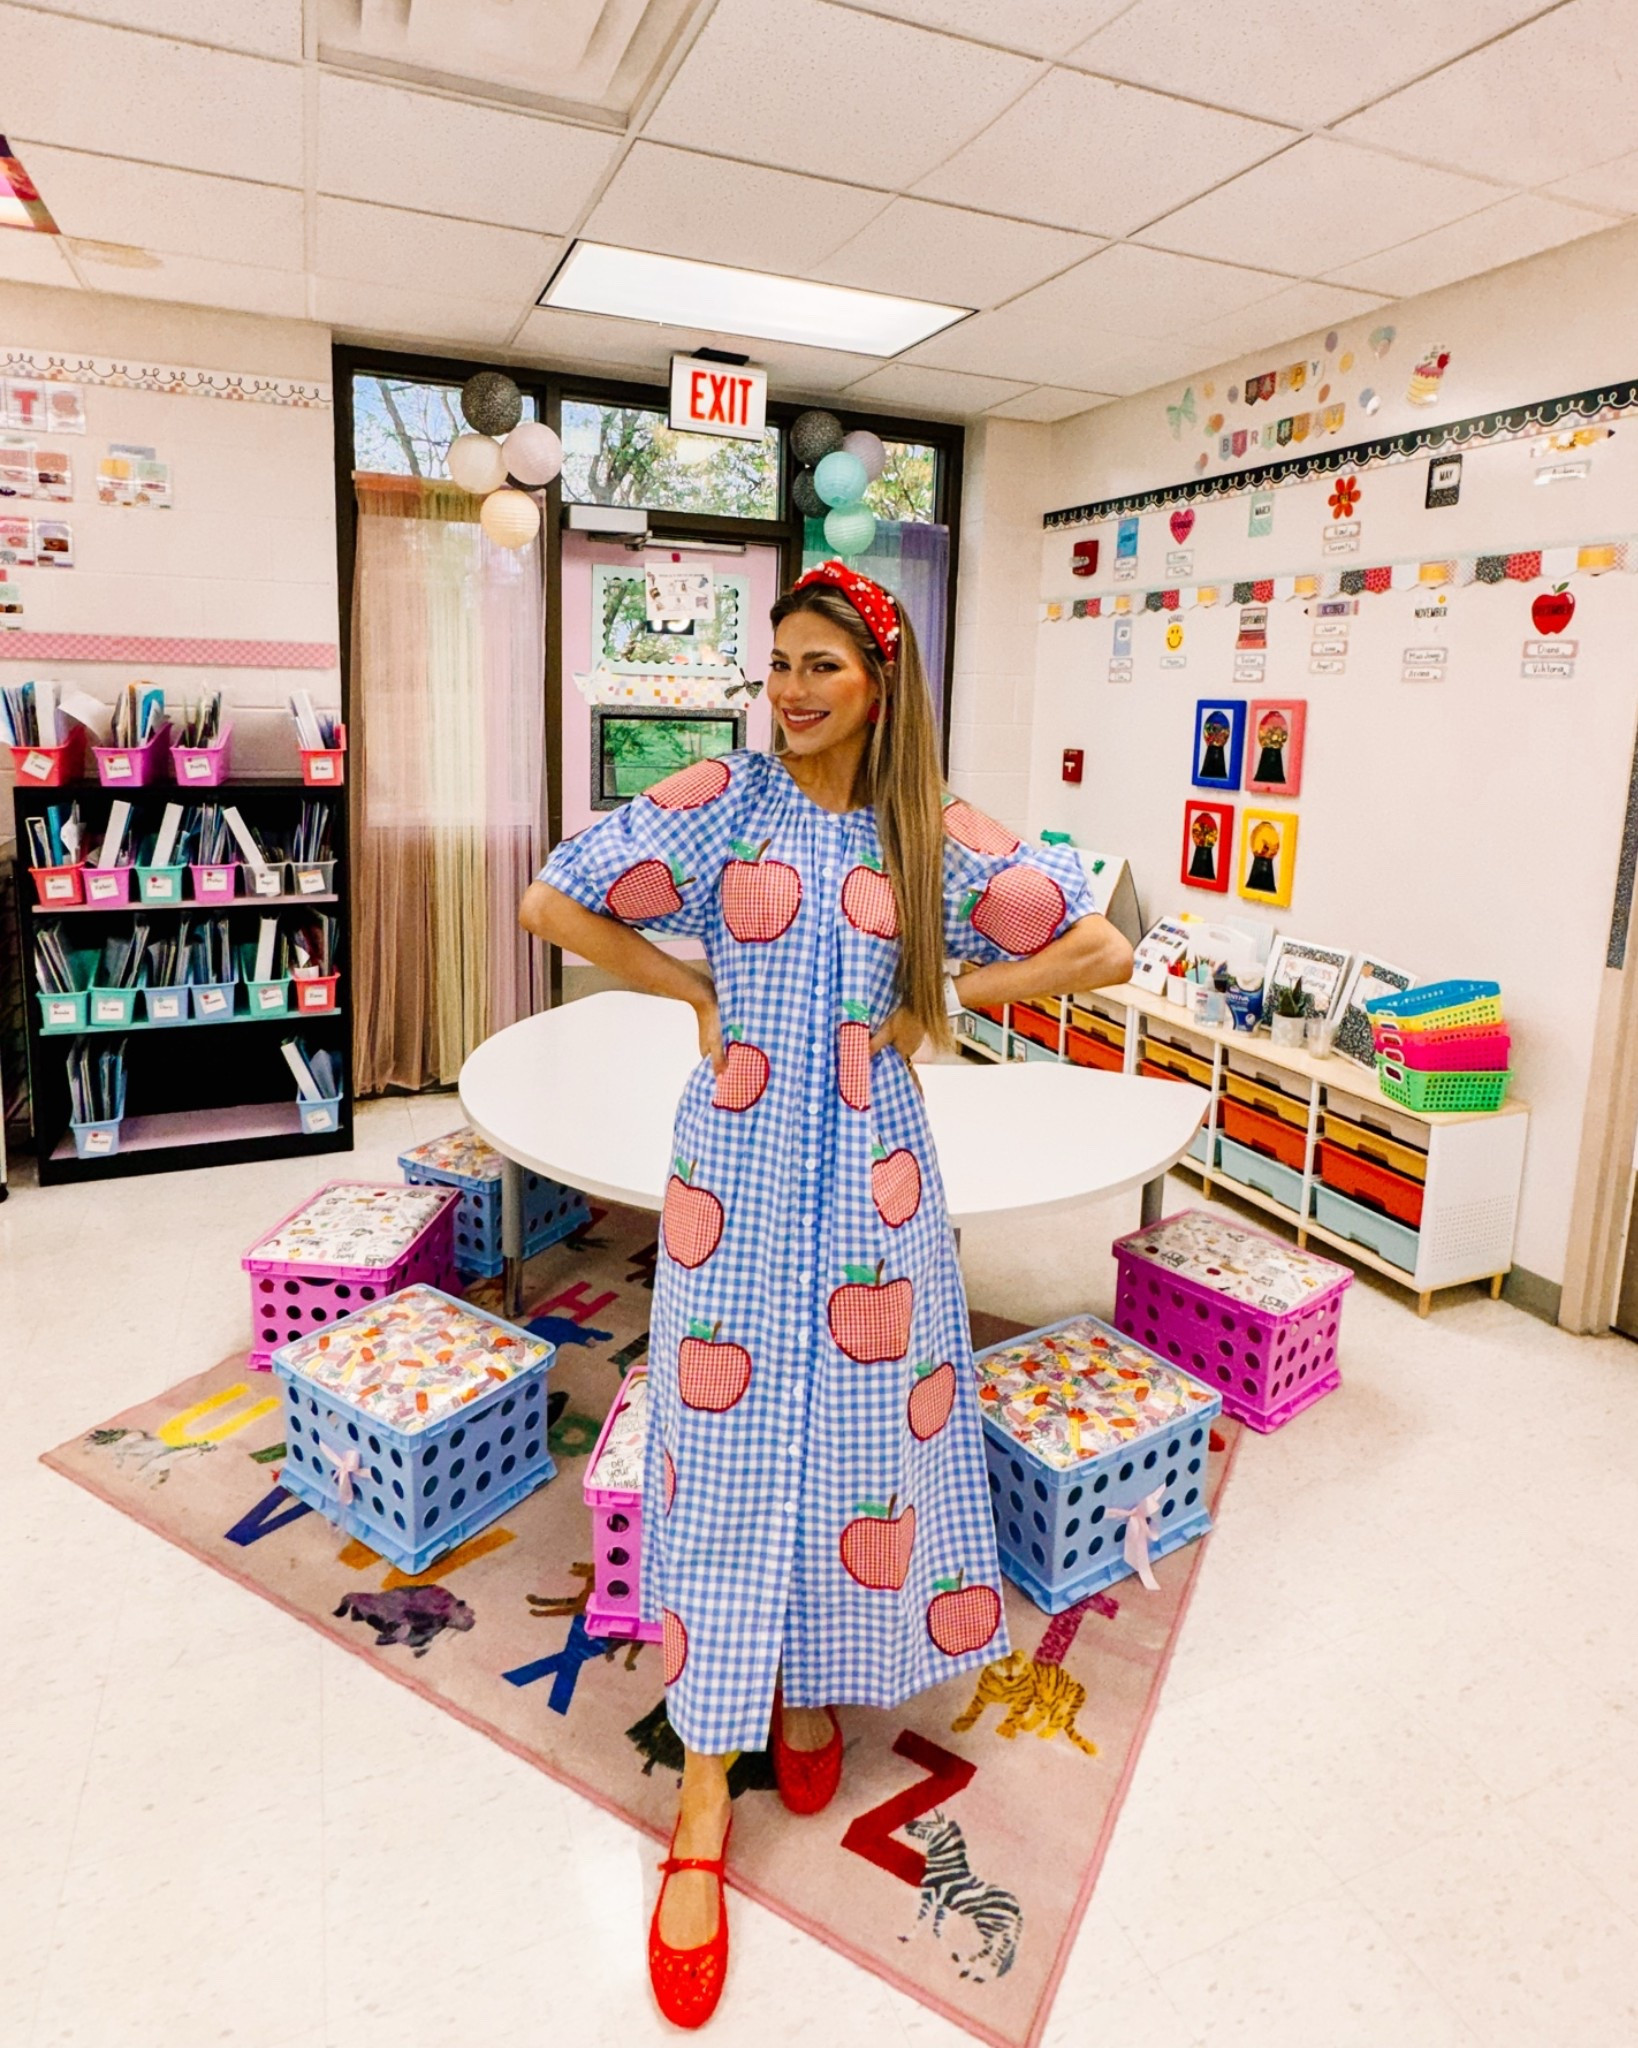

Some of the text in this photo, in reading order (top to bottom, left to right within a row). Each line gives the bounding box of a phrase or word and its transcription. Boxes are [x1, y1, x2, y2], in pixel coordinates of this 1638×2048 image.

[690, 371, 753, 426] EXIT
[1439, 469, 1453, 482] MAY
[1414, 606, 1448, 619] NOVEMBER
[157, 1382, 282, 1447] U
[841, 1729, 978, 1888] Z
